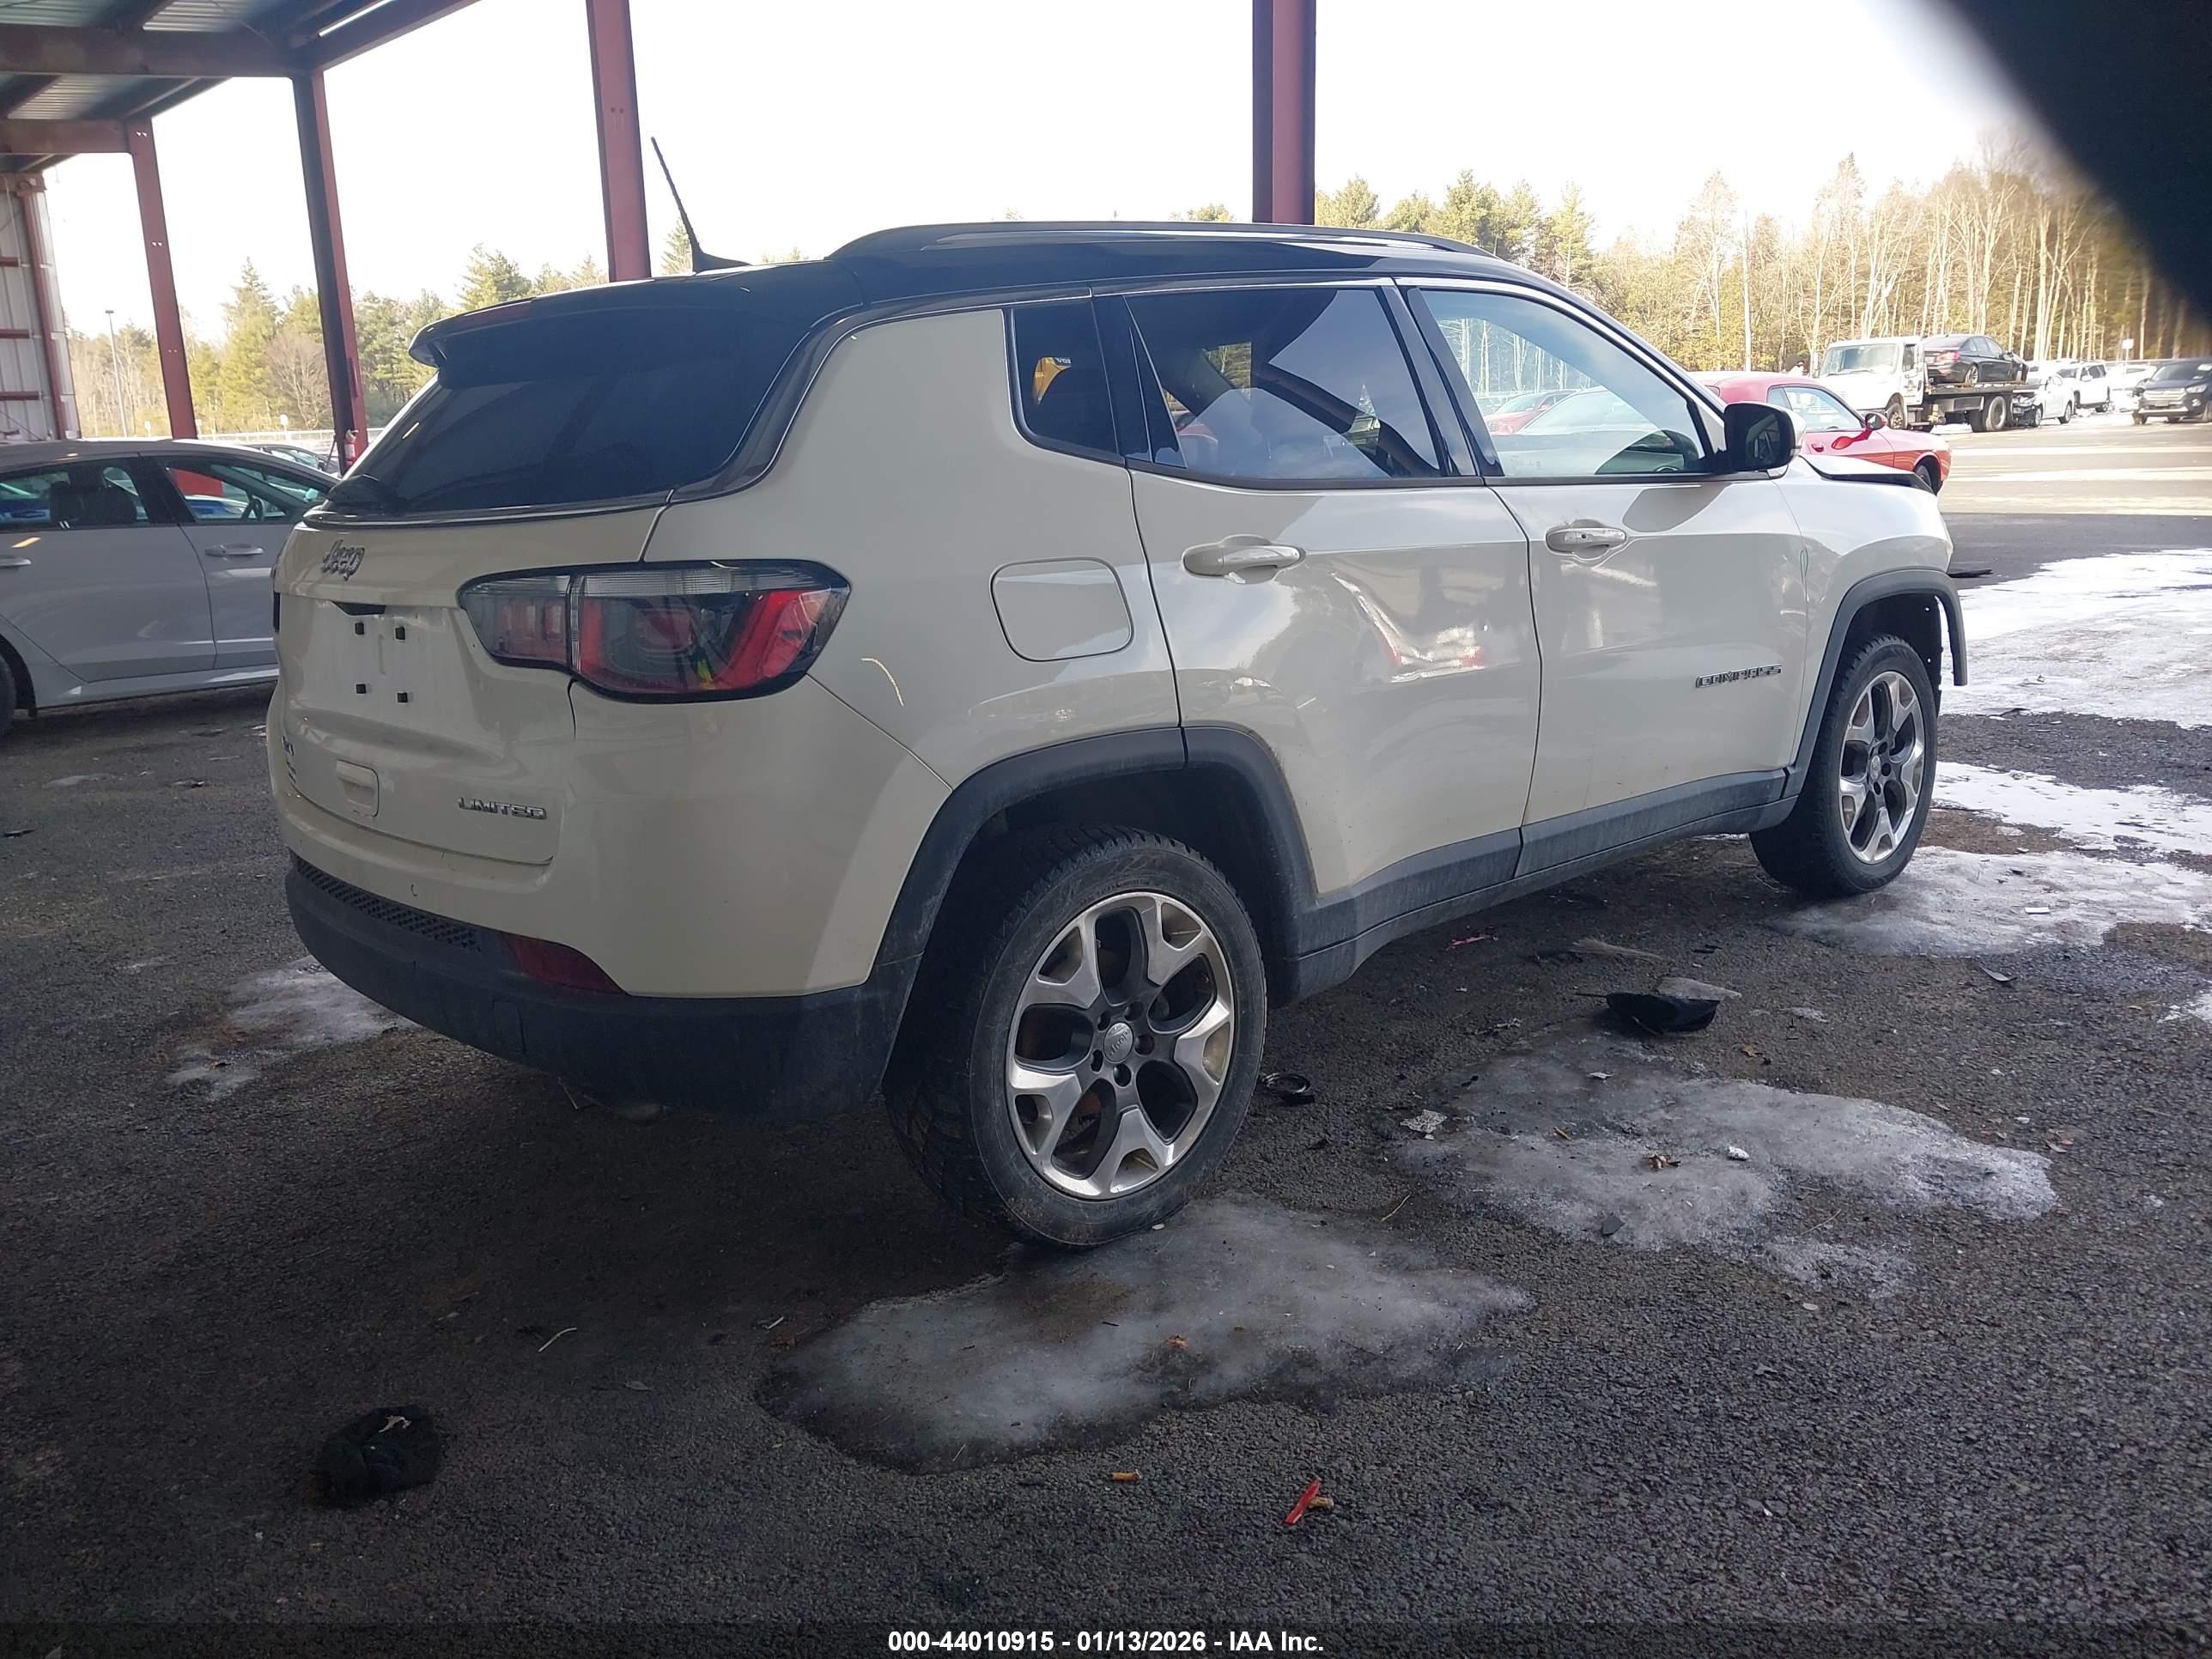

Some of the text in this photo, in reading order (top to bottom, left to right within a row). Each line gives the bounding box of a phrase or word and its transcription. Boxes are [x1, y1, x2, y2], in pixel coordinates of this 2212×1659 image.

[322, 538, 365, 581] Jeep
[1695, 663, 1783, 689] COMPASS
[458, 796, 547, 820] LIMITED
